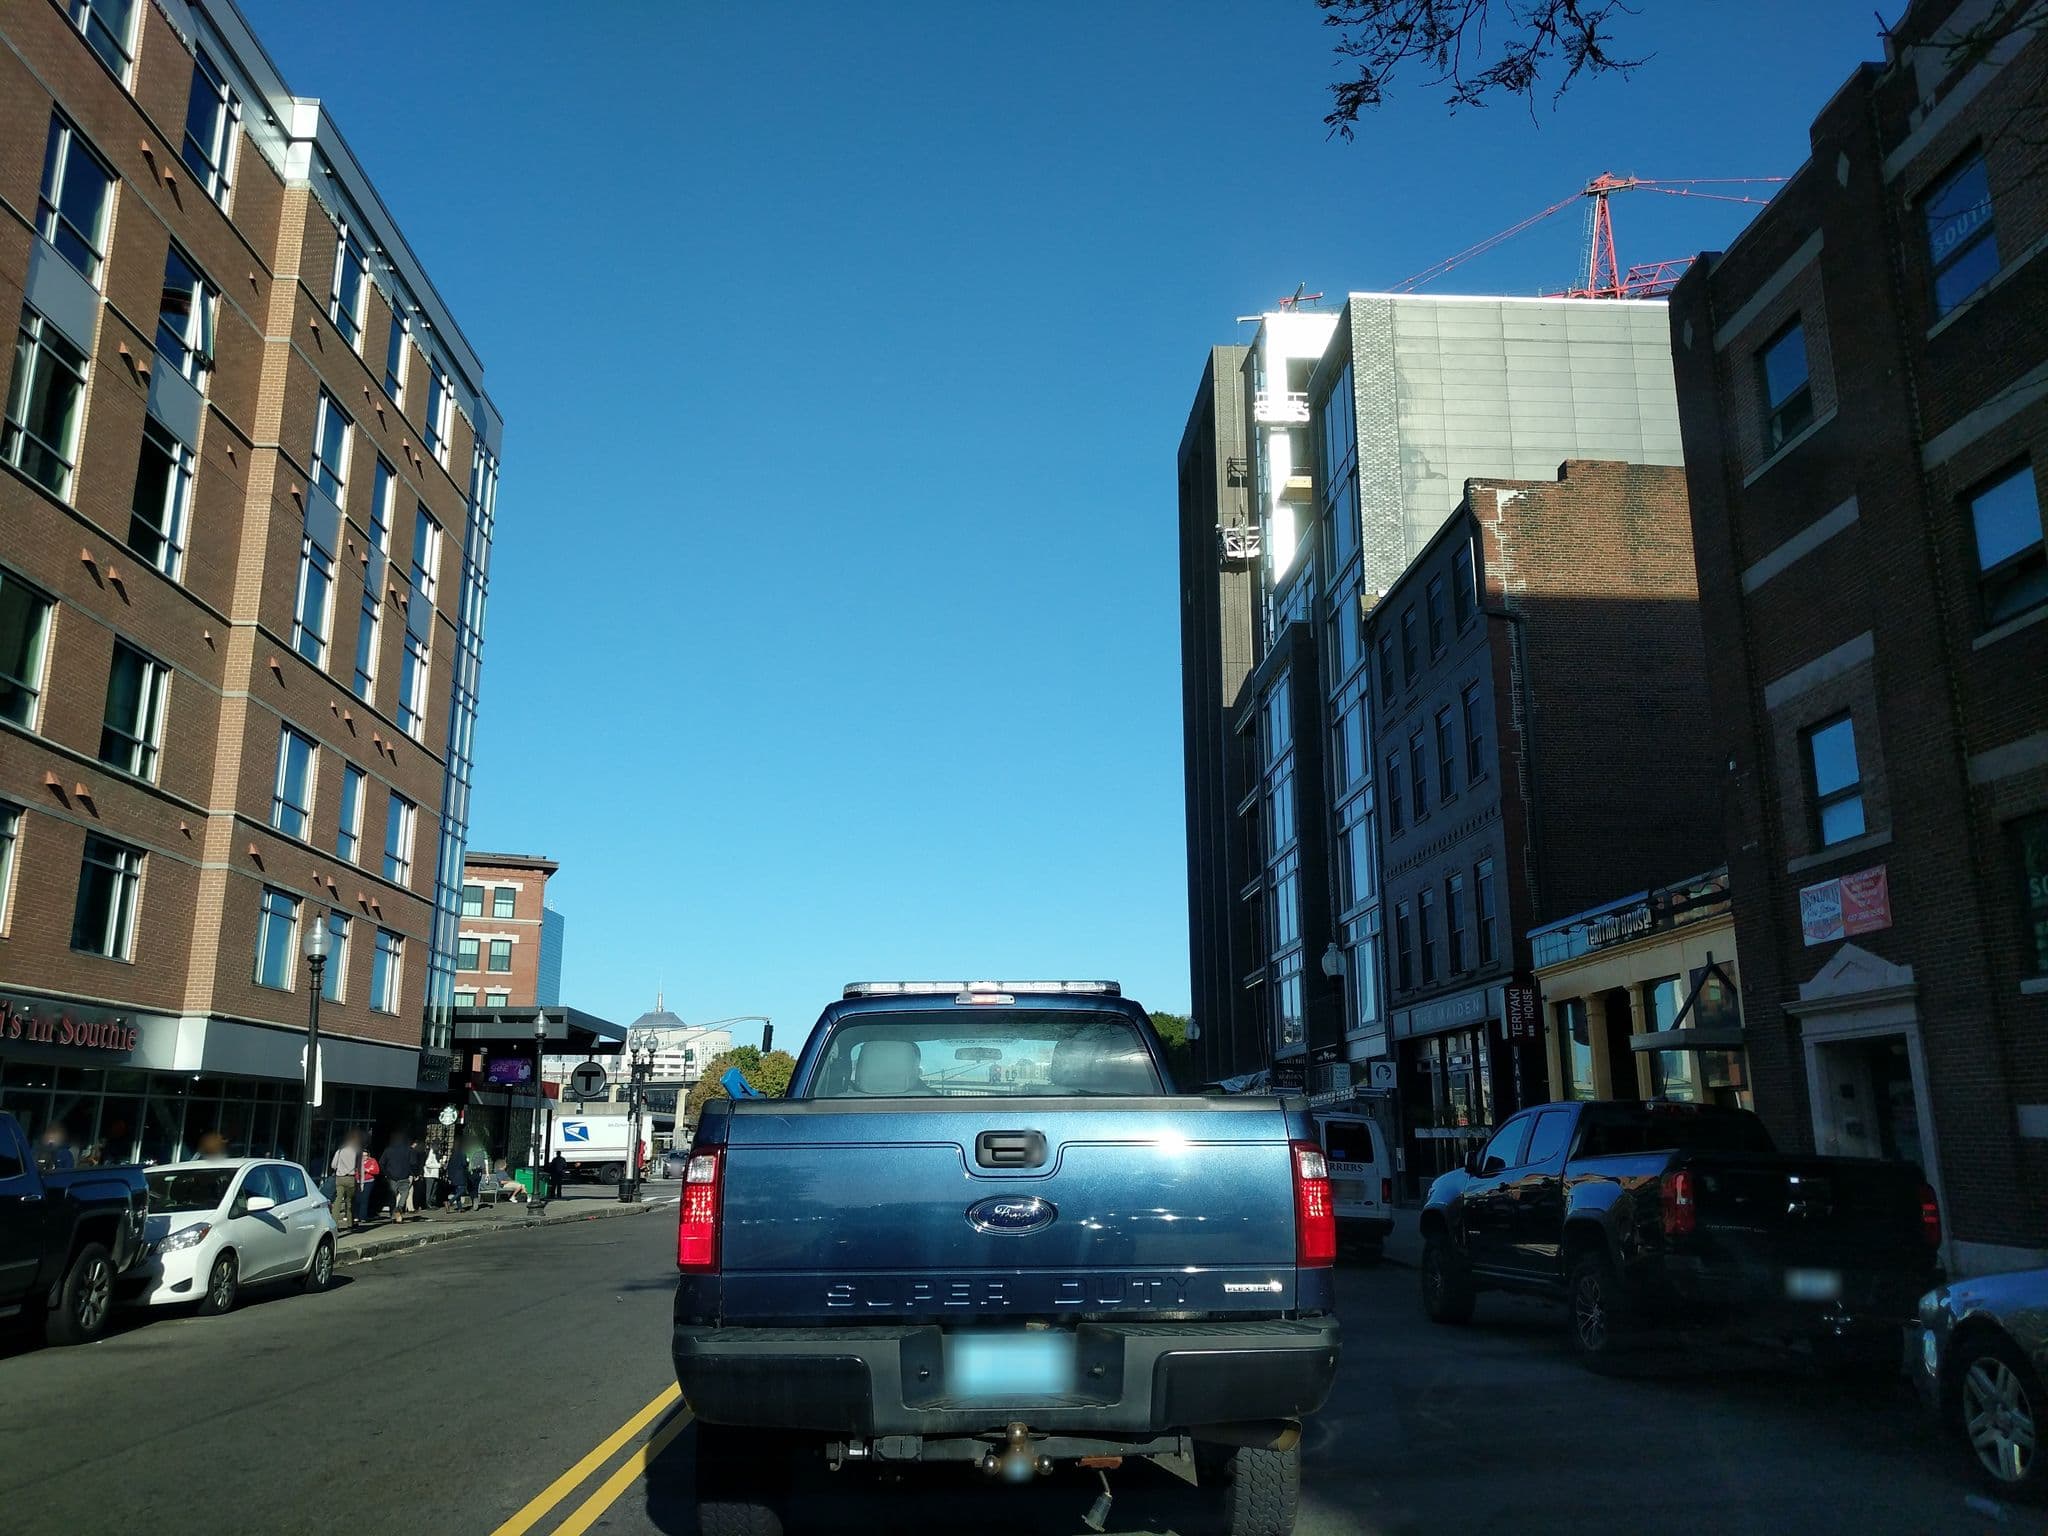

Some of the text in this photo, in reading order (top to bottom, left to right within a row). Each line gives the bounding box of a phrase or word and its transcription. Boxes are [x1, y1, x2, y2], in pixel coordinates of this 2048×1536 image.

[1509, 987, 1523, 1038] TERIYAKI
[1522, 988, 1535, 1021] HOUSE
[29, 1017, 54, 1042] in
[59, 1013, 137, 1051] Southie
[577, 1070, 601, 1092] T
[827, 1276, 1197, 1309] SUPER DUTY
